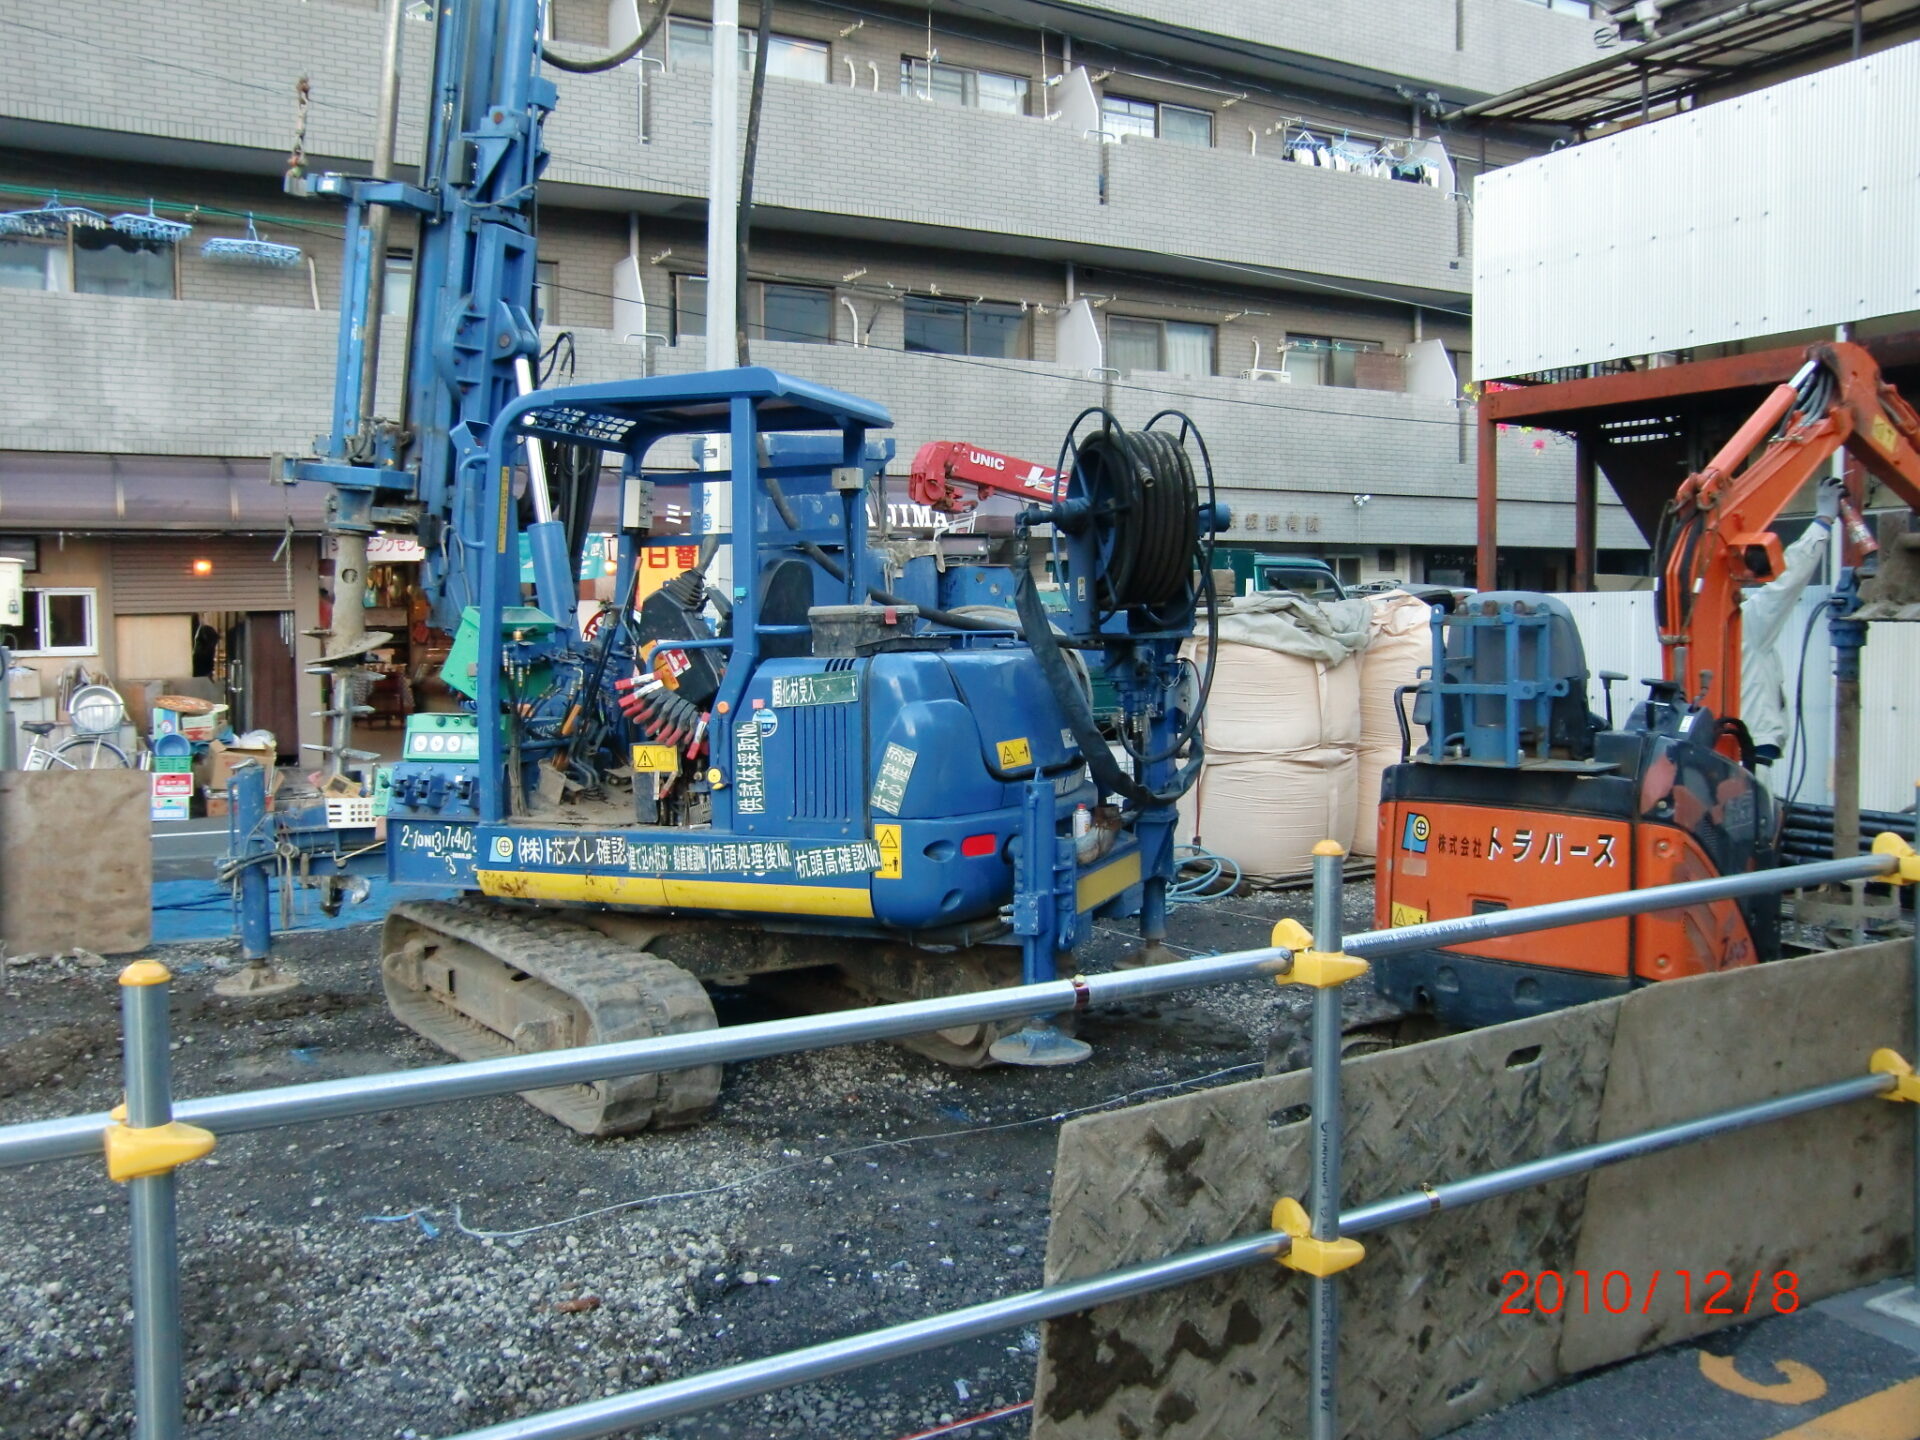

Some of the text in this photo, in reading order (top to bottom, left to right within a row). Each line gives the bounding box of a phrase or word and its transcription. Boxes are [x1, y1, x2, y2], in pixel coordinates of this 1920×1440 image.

[970, 451, 1005, 470] UNIC
[1438, 826, 1617, 868] 株式会社 トラバース
